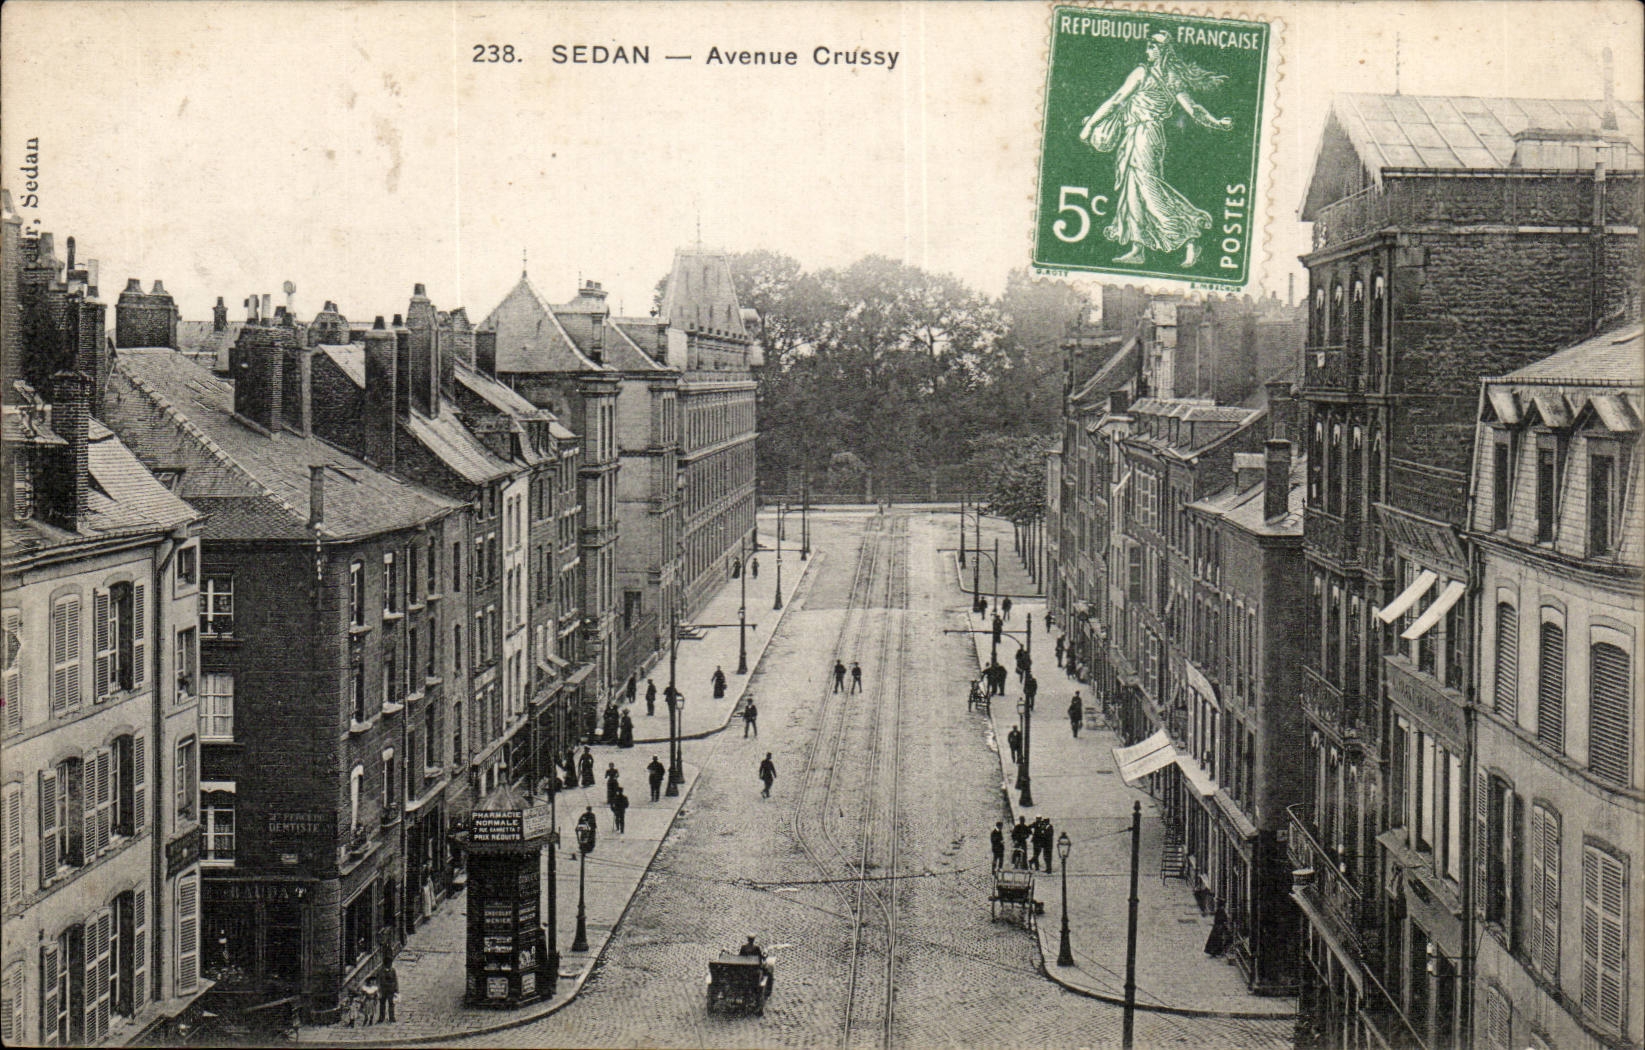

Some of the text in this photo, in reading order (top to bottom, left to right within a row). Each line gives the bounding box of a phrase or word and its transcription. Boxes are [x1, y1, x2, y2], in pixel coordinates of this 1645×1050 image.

[1061, 16, 1259, 50] REPUBLIQUE FRANÇAISE
[1220, 183, 1246, 268] POSTES
[472, 811, 521, 820] PHARMACIE
[268, 822, 320, 833] DENTISTE
[476, 819, 519, 827] NORMALE
[474, 833, 490, 841] PRIX
